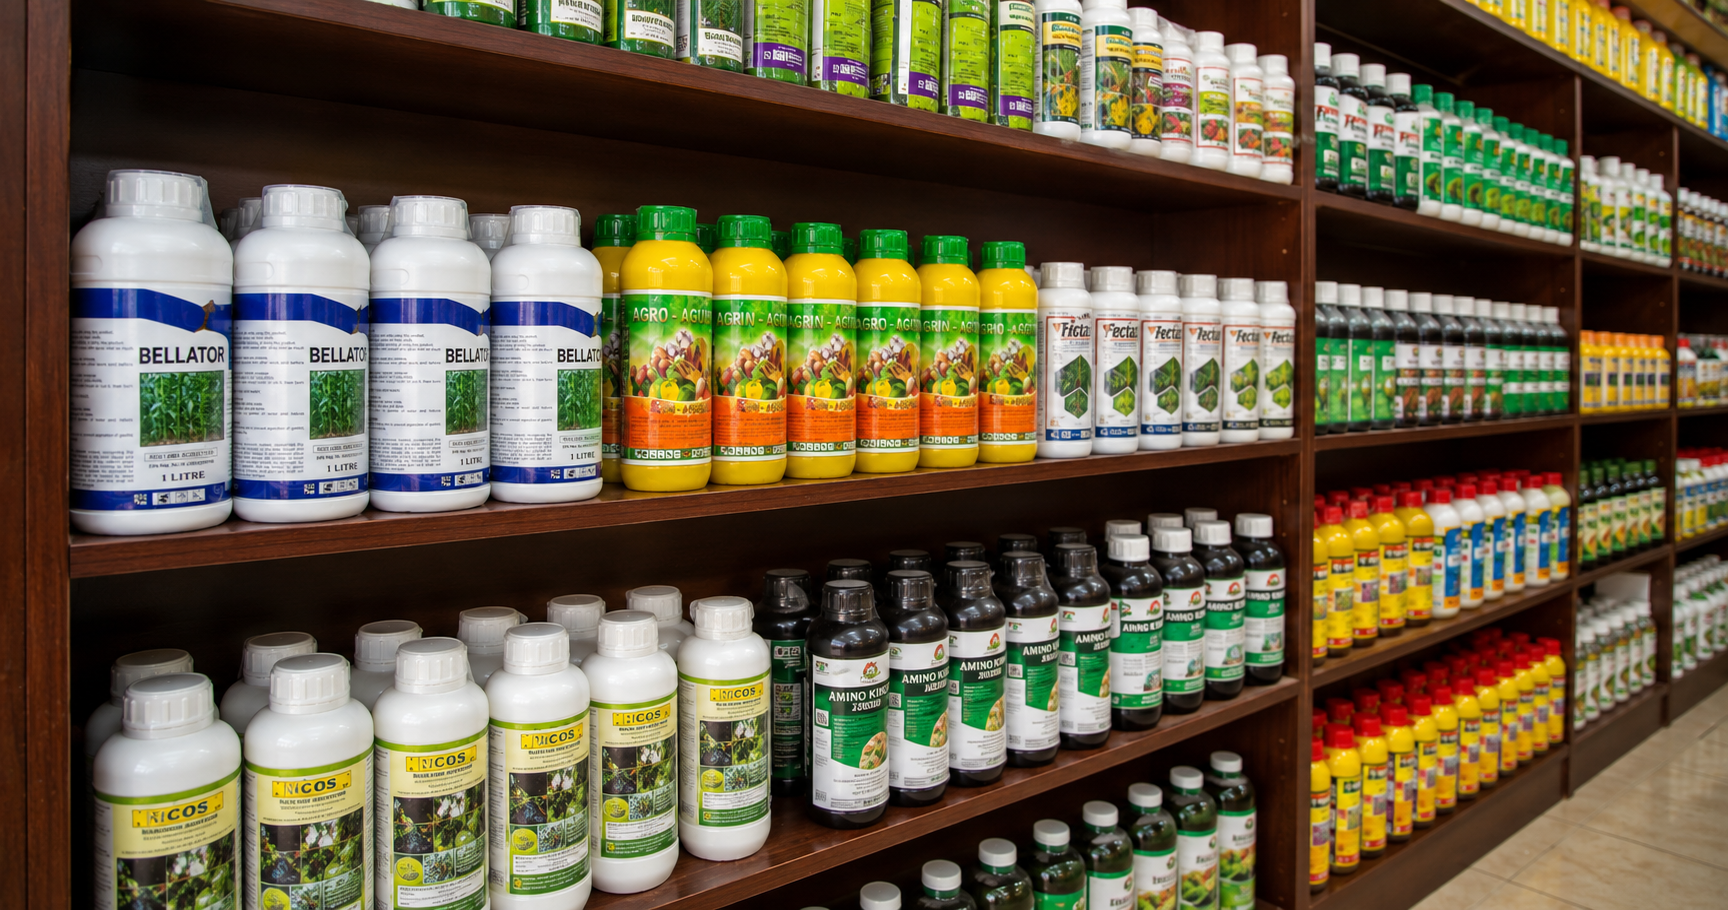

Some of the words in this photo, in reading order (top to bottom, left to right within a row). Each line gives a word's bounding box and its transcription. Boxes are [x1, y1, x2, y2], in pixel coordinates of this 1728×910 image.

[633, 307, 668, 323] AGRO
[139, 346, 225, 364] BELLATOR
[334, 462, 358, 472] LITRE
[162, 474, 167, 482] 1
[171, 470, 206, 482] LITRE
[959, 659, 993, 671] AMINO
[901, 671, 936, 684] AMINO
[828, 690, 867, 702] AMINO
